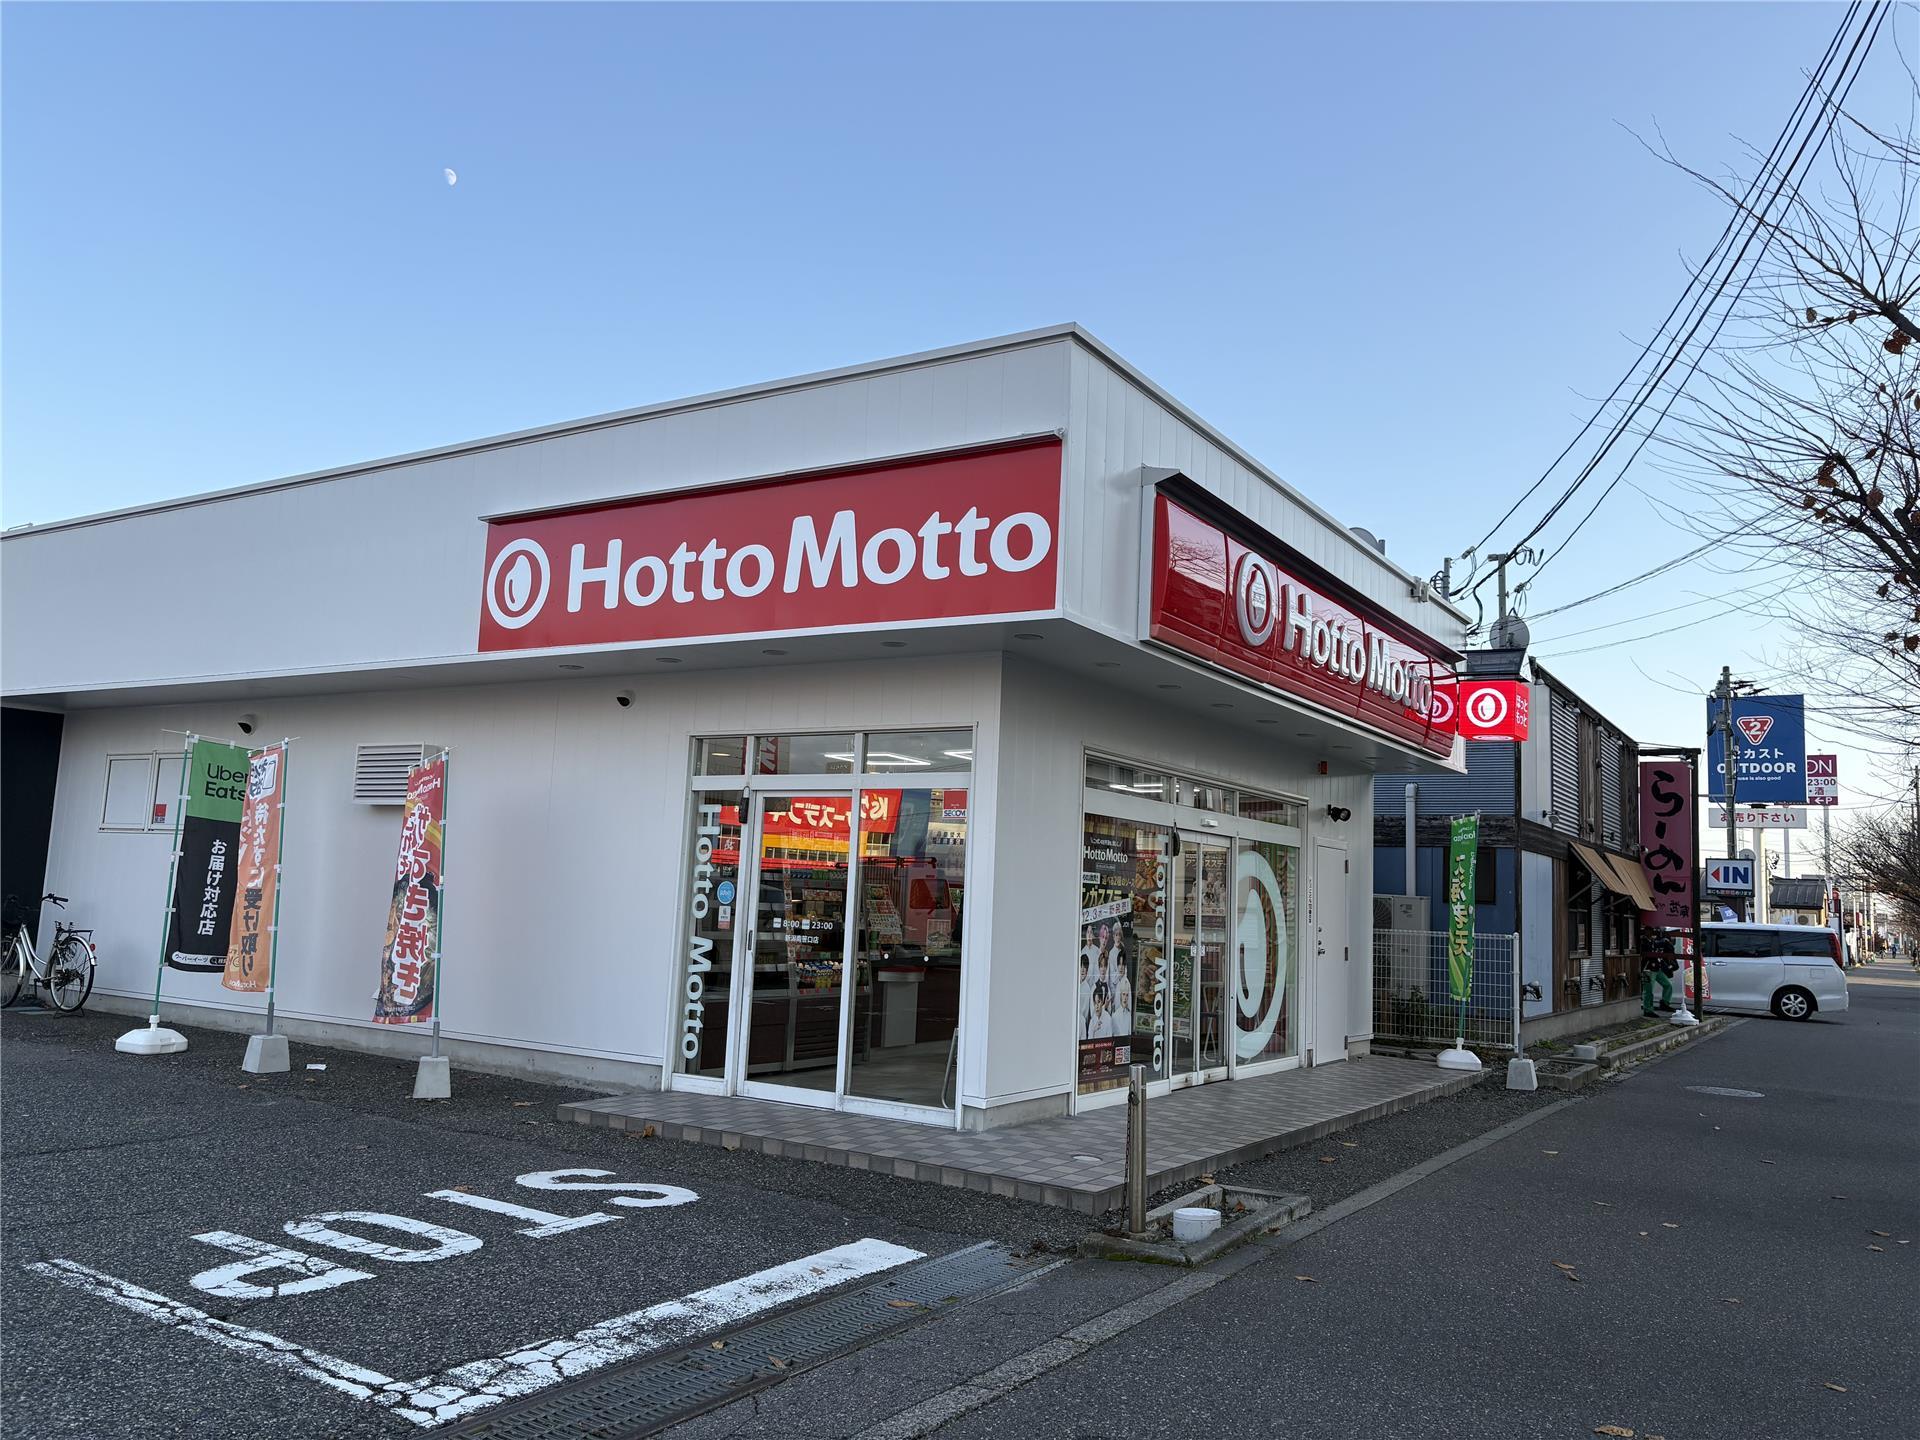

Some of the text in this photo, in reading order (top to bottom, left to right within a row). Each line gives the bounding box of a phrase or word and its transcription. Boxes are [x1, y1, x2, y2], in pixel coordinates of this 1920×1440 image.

[1516, 694, 1528, 713] ほっと
[1516, 710, 1528, 728] もっと
[207, 763, 249, 783] Uber
[1716, 762, 1797, 774] OTDOOR
[1807, 759, 1832, 774] ON
[205, 782, 246, 802] Eats
[1645, 770, 1686, 896] らーめん
[1723, 866, 1749, 884] IN
[197, 839, 227, 936] お届け対応店
[681, 804, 721, 1060] Hotto Motto
[782, 920, 800, 928] 8:00
[811, 921, 833, 930] 23:00
[1153, 834, 1169, 1072] Hotto Motto
[190, 1168, 701, 1299] STOP
